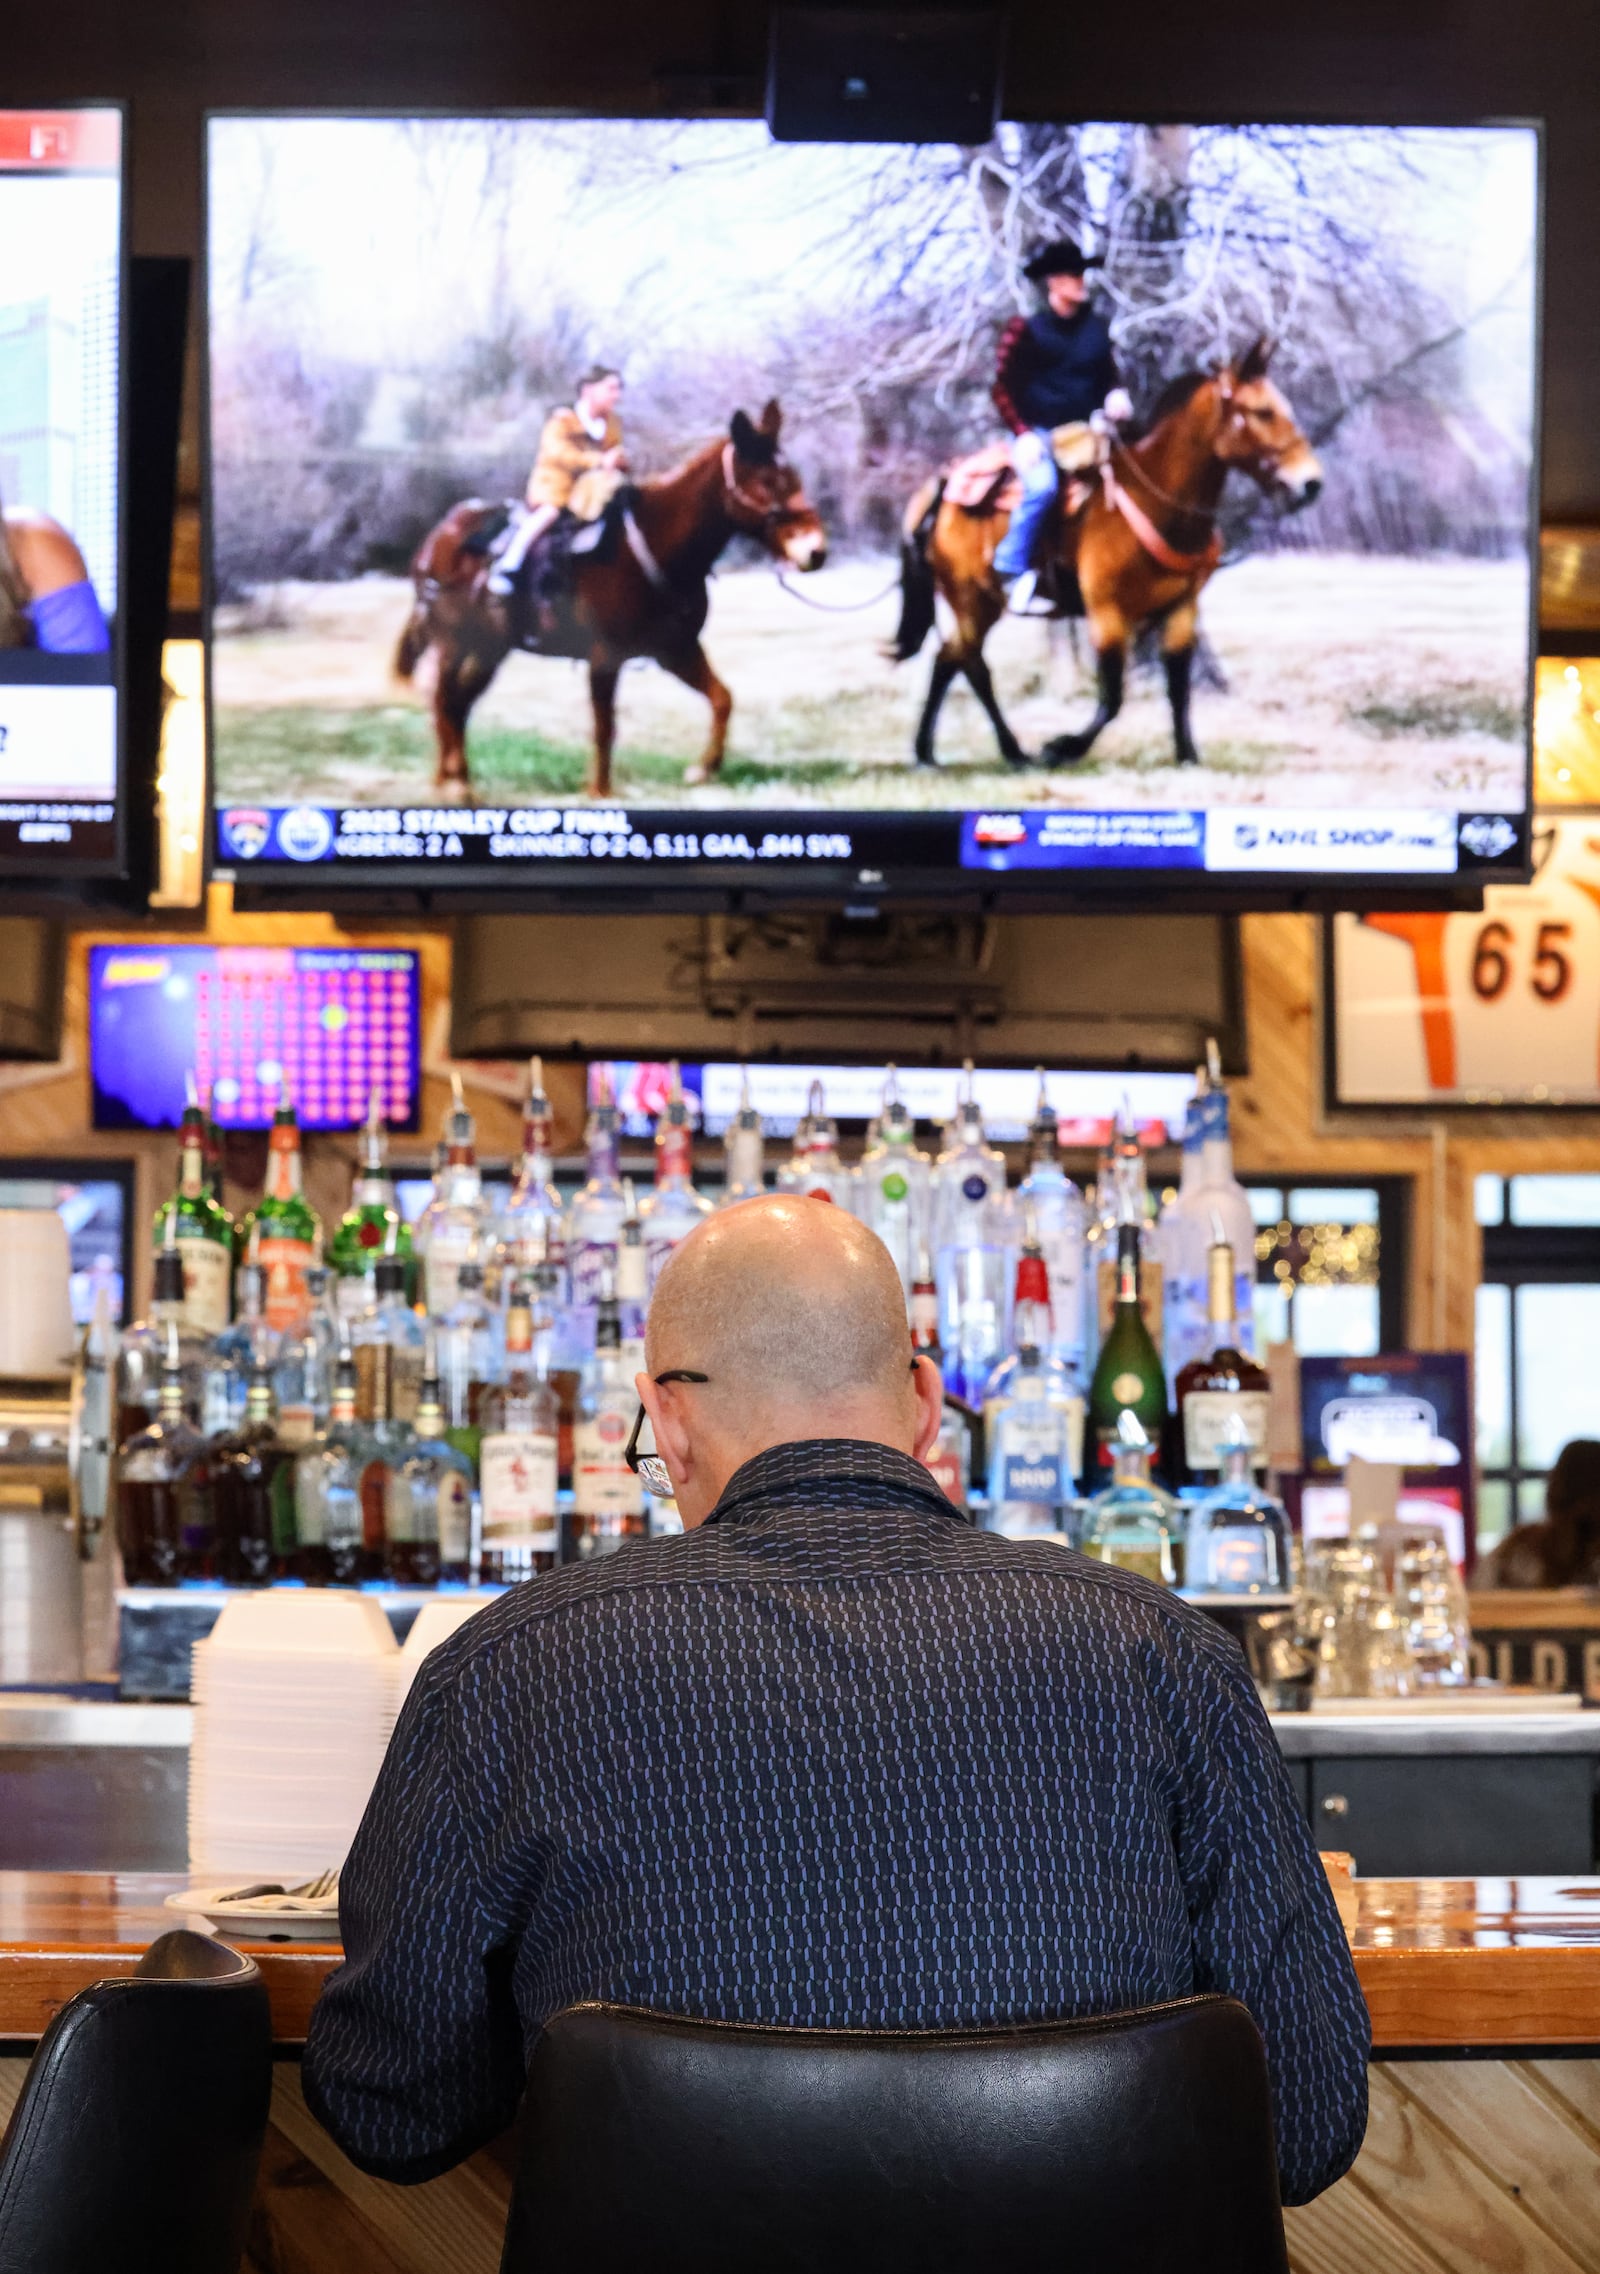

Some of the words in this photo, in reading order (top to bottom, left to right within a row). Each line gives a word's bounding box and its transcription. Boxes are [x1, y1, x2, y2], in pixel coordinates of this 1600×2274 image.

[402, 809, 508, 834] STANLEY
[508, 809, 561, 834] CUP
[562, 809, 632, 834] FINAL
[425, 834, 443, 857] 2
[443, 833, 463, 857] A
[1472, 921, 1573, 1003] 65
[1009, 1467, 1056, 1488] 1800
